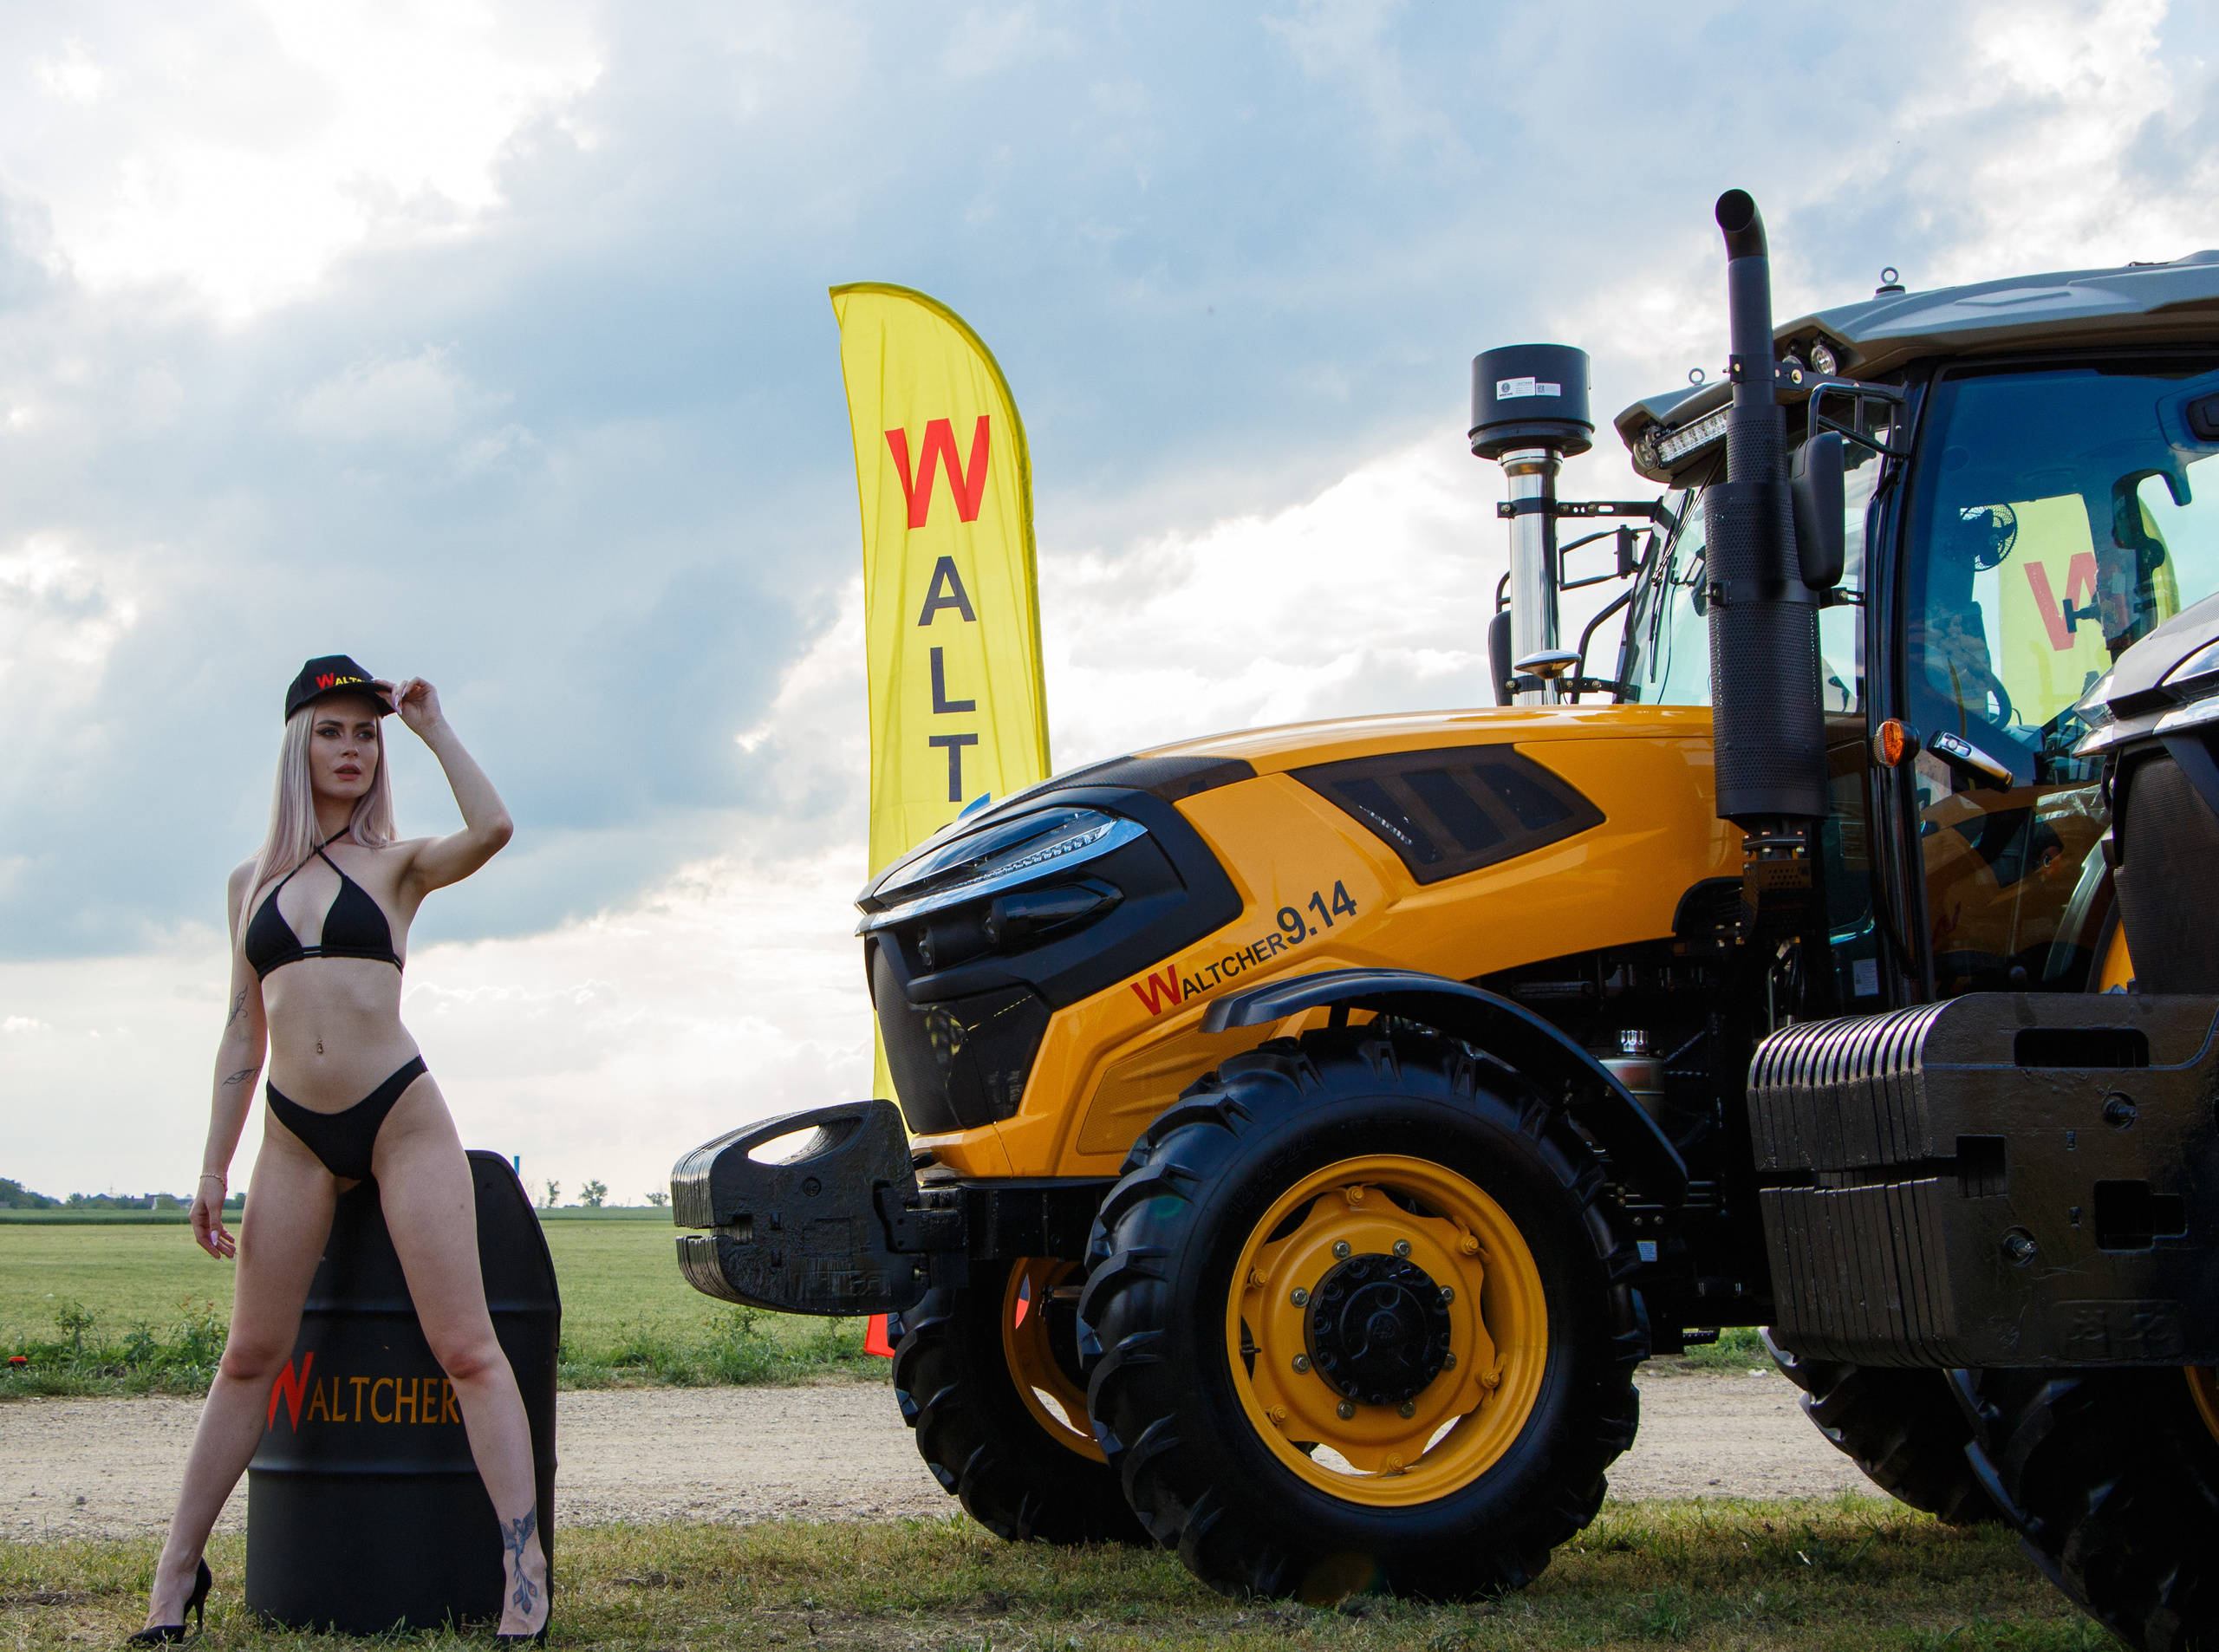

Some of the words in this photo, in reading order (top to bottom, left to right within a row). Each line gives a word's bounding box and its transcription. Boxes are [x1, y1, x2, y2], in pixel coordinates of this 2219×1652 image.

[884, 414, 991, 803] WALT
[1130, 933, 1288, 1017] WALTCHER
[1276, 880, 1357, 945] 9.14
[268, 1352, 460, 1434] WALTCHER
